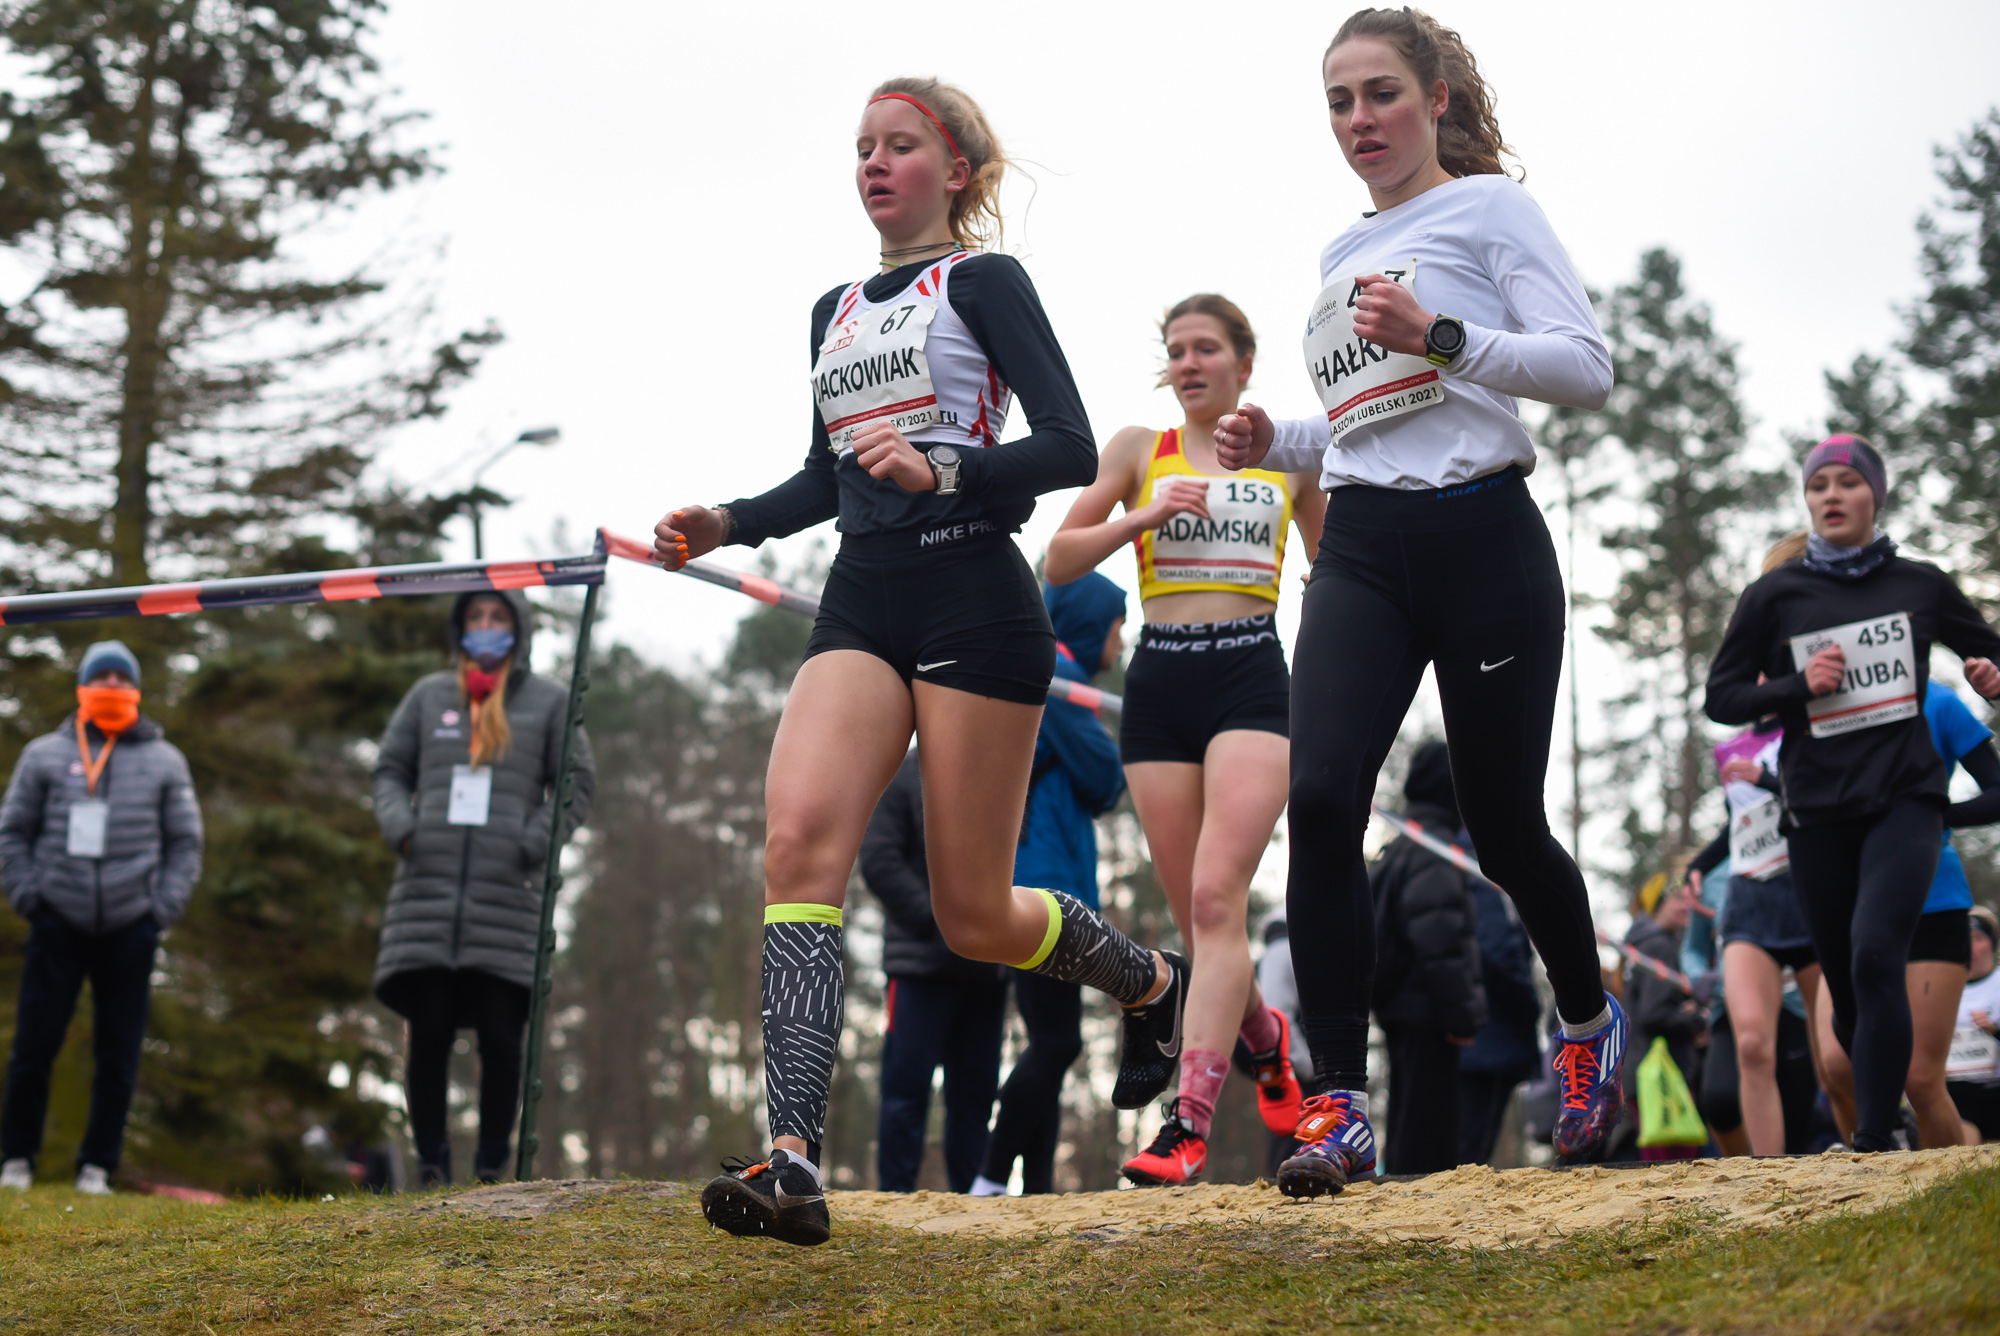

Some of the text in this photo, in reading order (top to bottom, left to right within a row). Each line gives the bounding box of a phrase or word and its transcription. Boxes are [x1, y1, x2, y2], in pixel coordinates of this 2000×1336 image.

[880, 305, 917, 335] 67
[907, 411, 933, 426] 2021
[1330, 413, 1357, 438] ASZÓW
[1357, 396, 1406, 420] LUBELSKI
[1408, 387, 1438, 405] 2021
[1226, 482, 1274, 506] 153
[920, 524, 965, 547] NIKE
[1157, 518, 1271, 547] ADAMSKA
[1214, 570, 1253, 580] LUBELSKI
[1857, 619, 1905, 647] 455
[1828, 658, 1909, 696] IUBA
